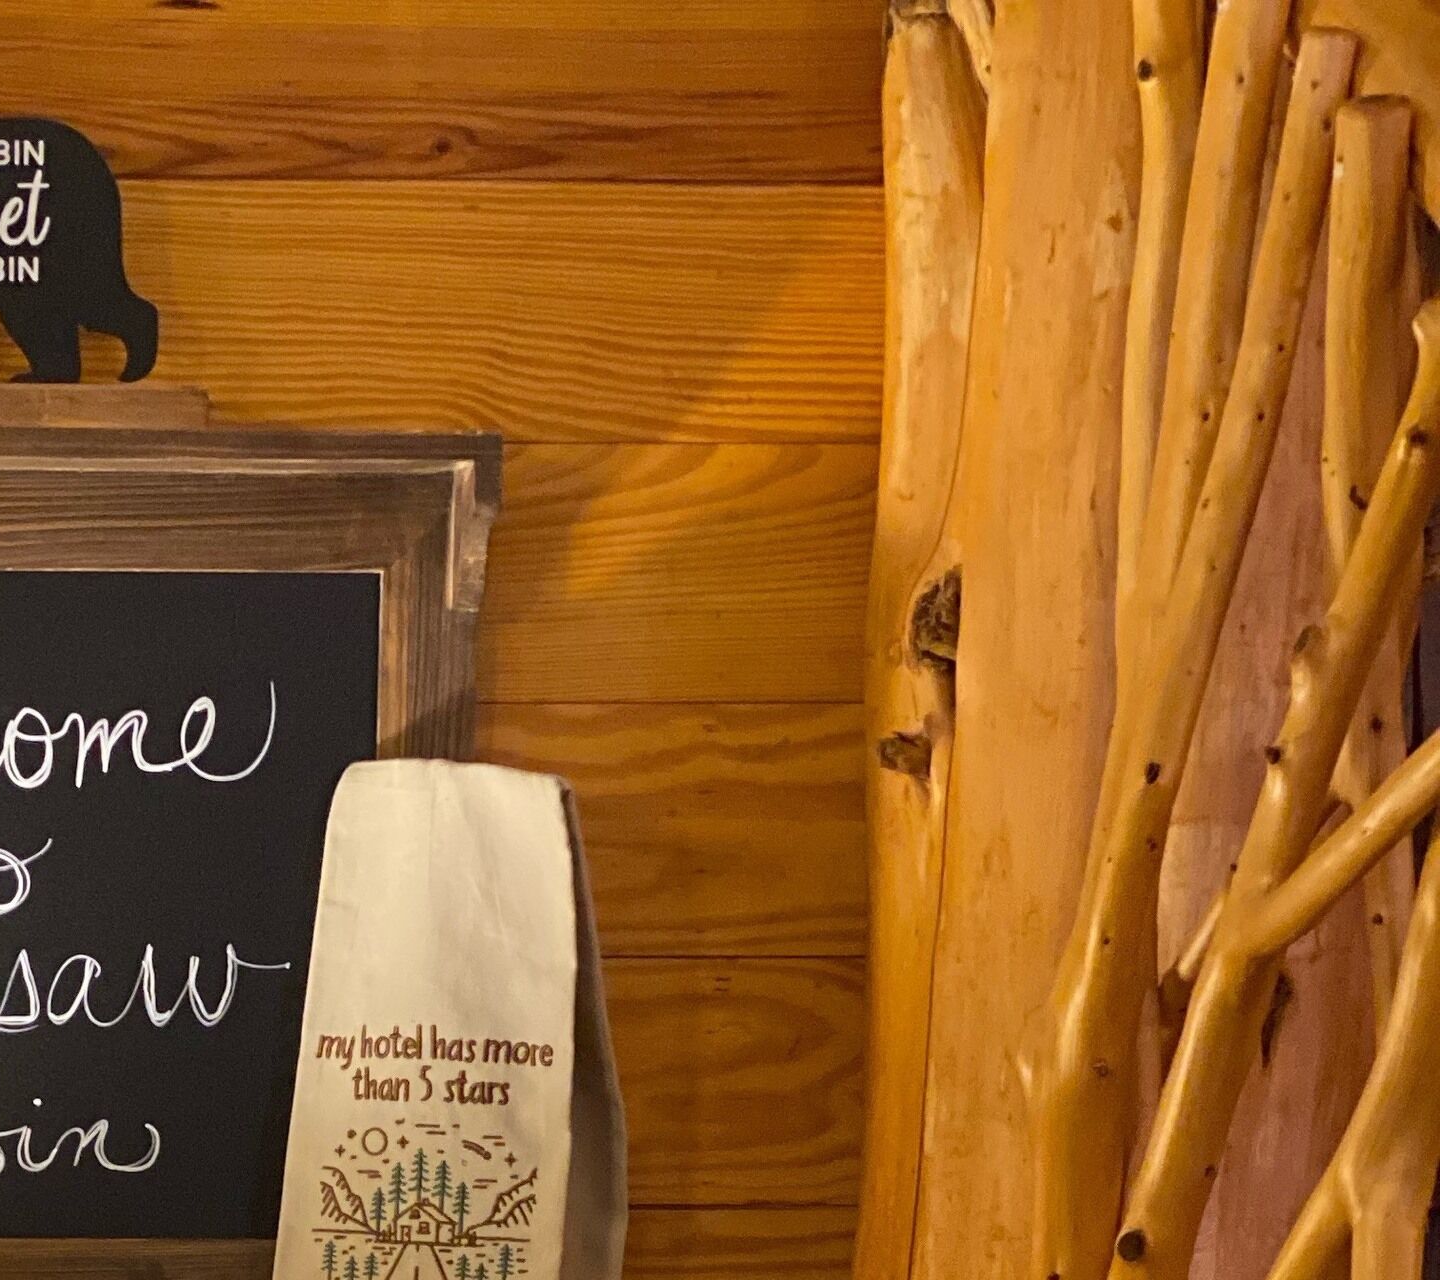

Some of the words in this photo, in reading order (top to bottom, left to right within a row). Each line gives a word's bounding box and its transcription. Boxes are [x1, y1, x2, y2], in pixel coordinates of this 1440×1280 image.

[315, 1032, 356, 1070] my
[359, 1023, 423, 1060] hotel
[429, 1023, 478, 1063] has
[482, 1037, 555, 1067] more
[351, 1066, 411, 1102] than
[418, 1064, 433, 1102] 5
[442, 1069, 511, 1106] stars
